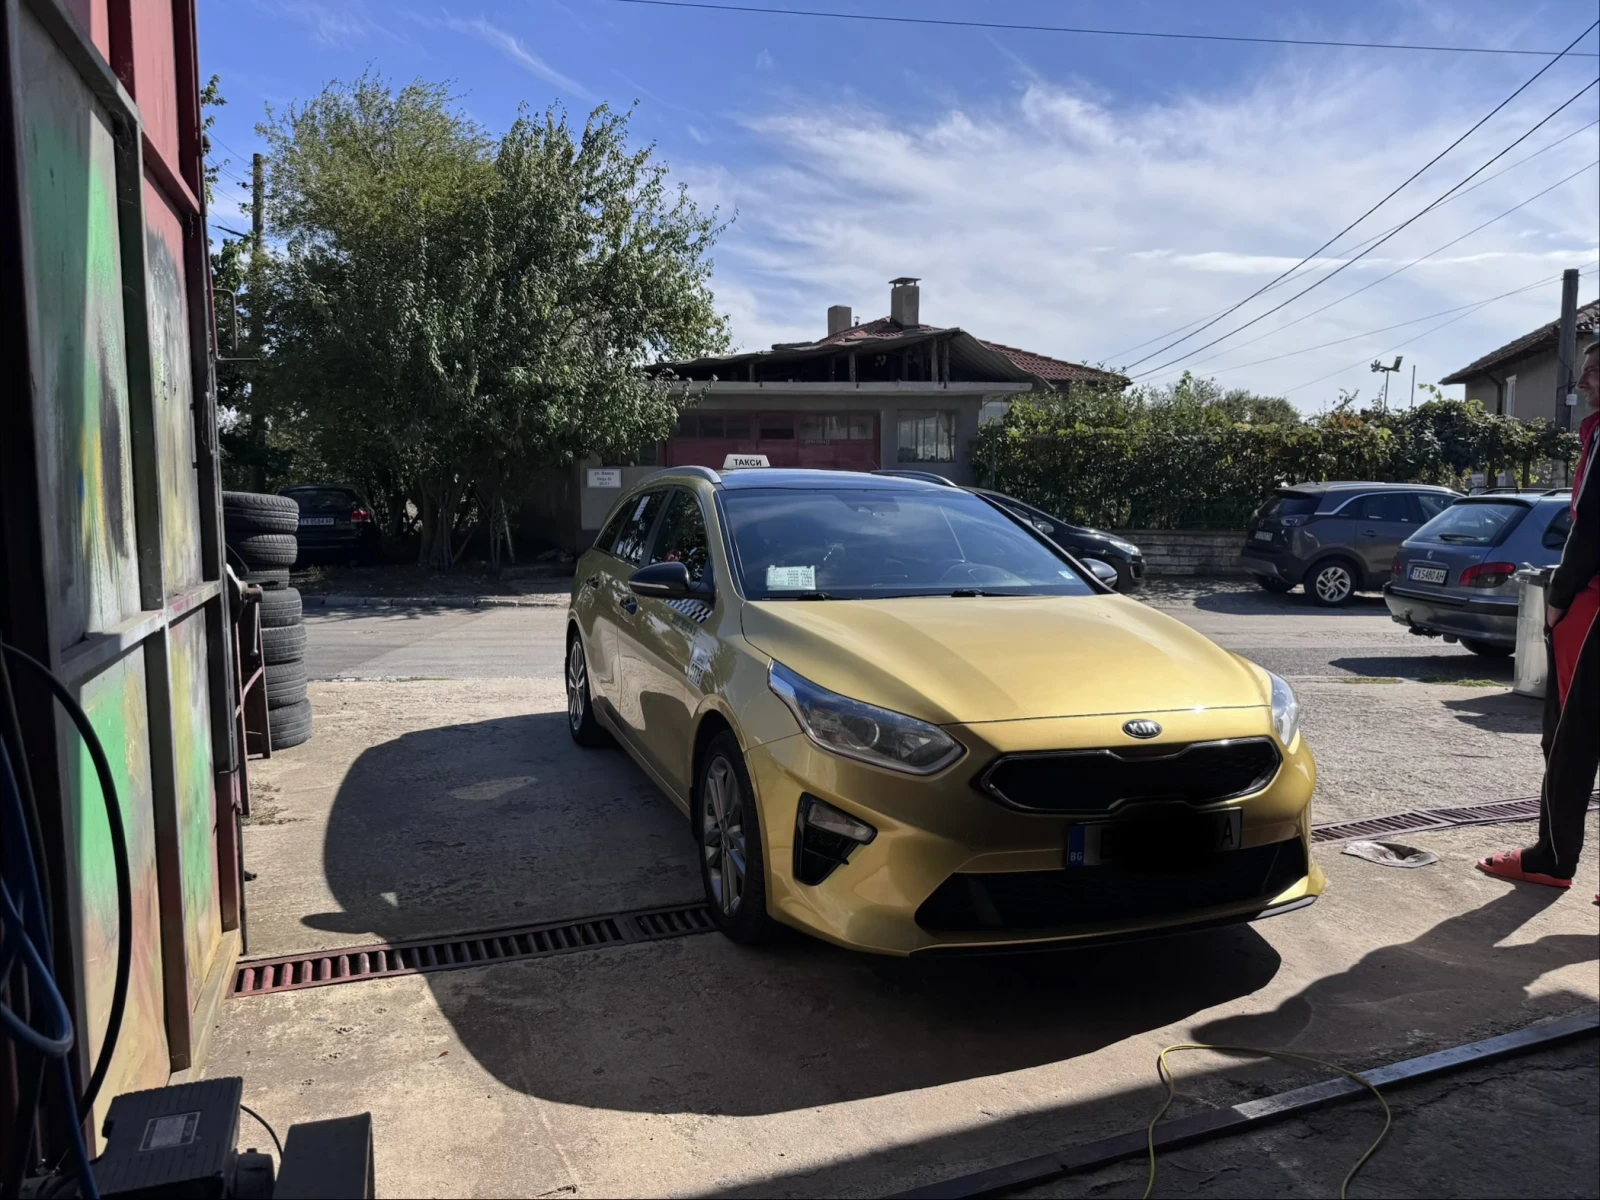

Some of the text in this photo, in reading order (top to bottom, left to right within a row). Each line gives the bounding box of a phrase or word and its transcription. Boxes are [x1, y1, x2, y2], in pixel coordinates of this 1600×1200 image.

[733, 459, 762, 467] ТАКСИ
[1128, 722, 1158, 734] KIA
[1070, 852, 1083, 862] BG
